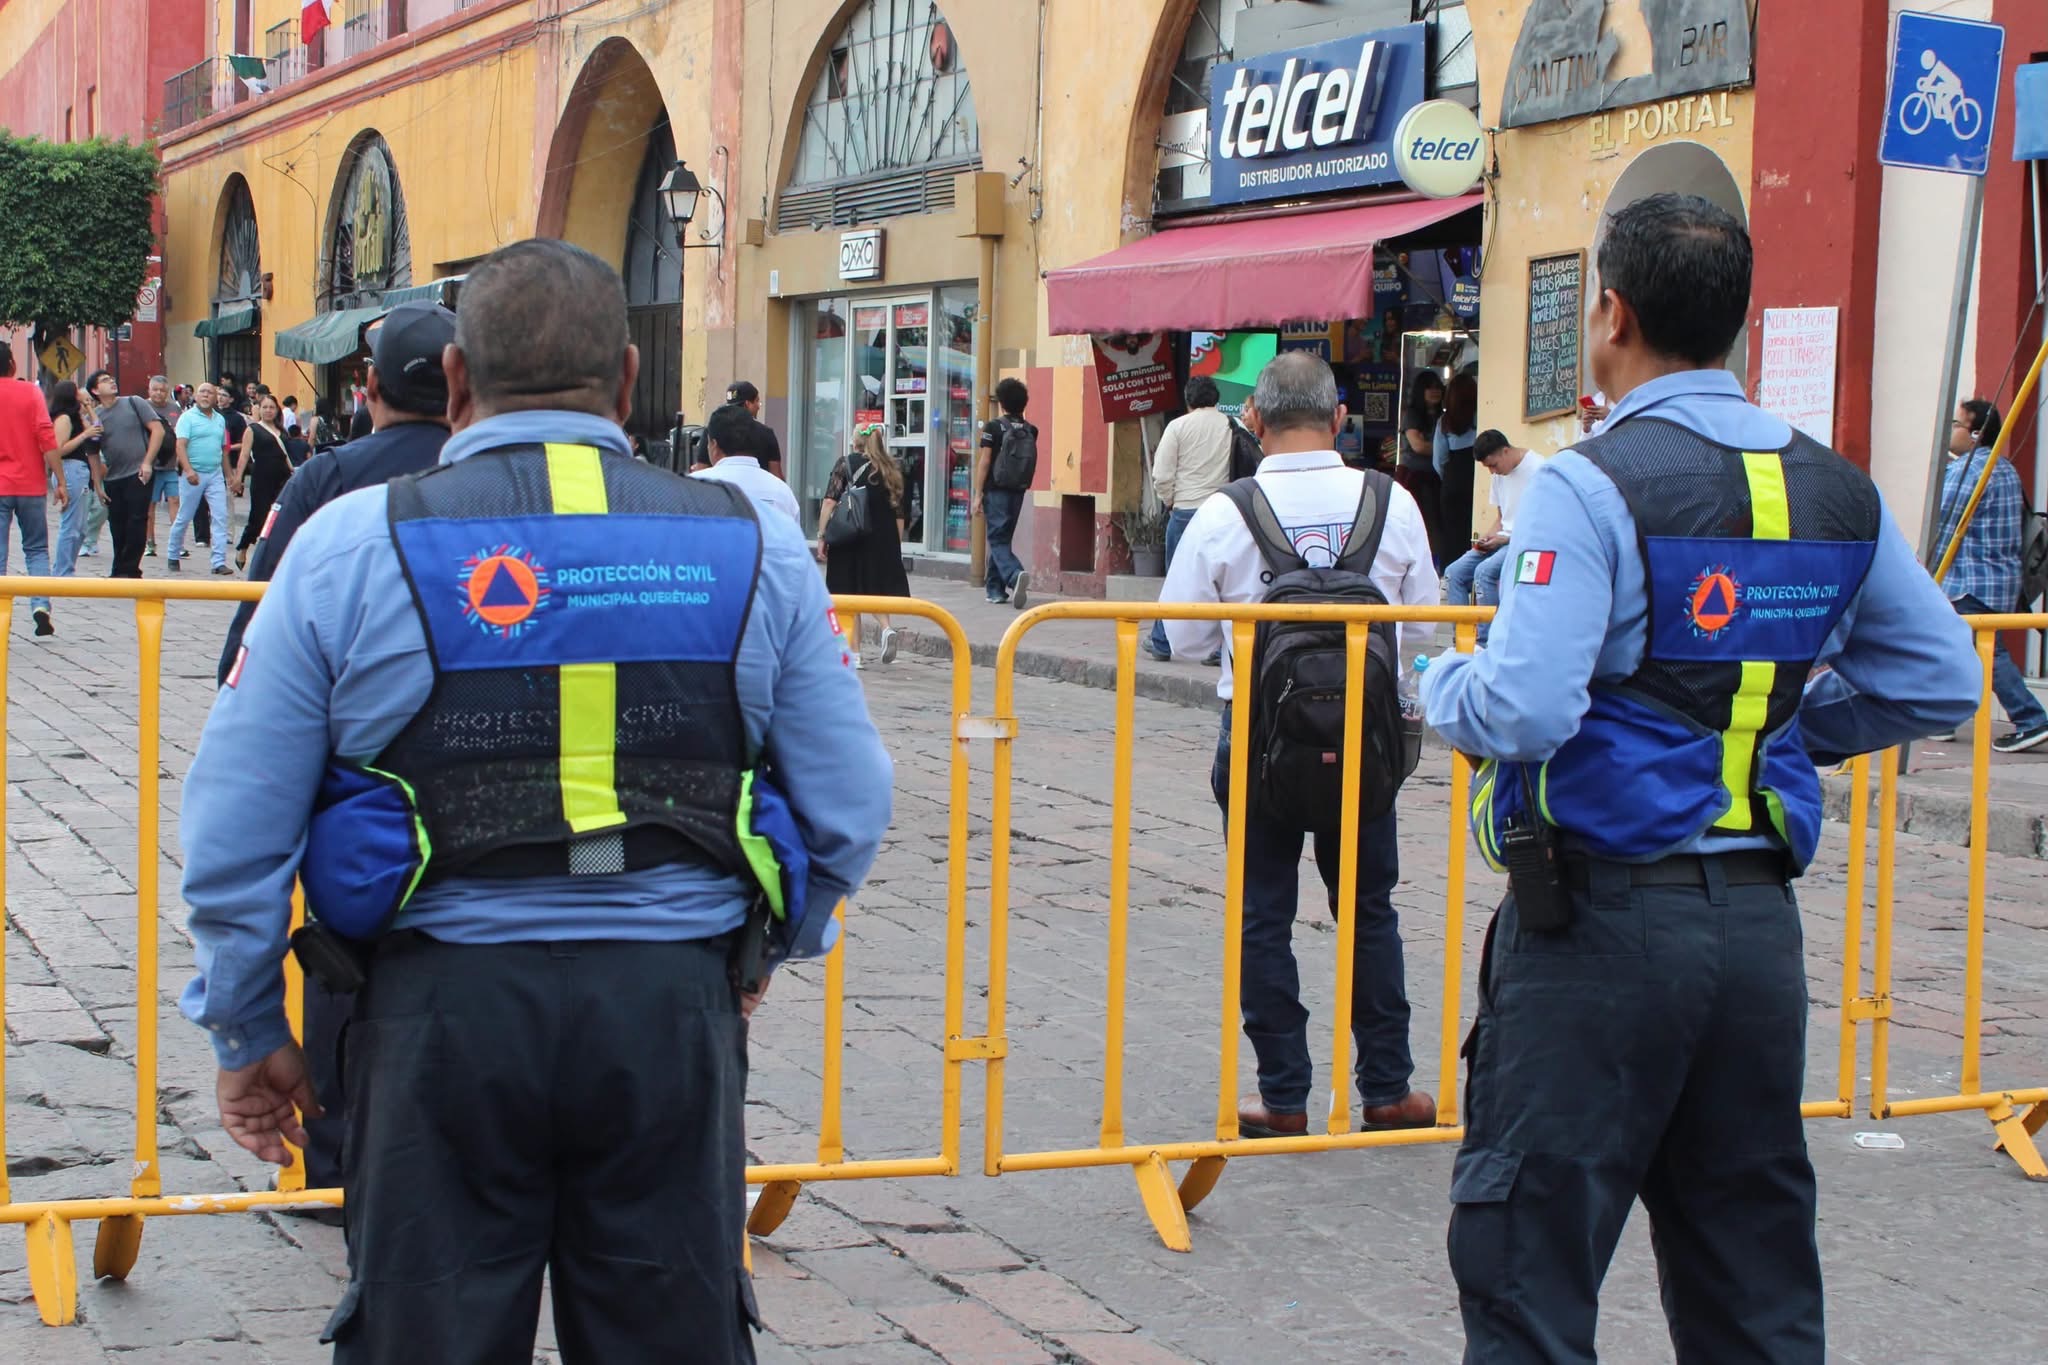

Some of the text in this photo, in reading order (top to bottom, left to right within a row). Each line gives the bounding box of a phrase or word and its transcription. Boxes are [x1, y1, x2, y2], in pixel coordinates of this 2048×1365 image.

[1680, 20, 1728, 68] BAR
[1219, 40, 1376, 159] telcel
[1590, 92, 1734, 153] EL PORTAL
[1410, 137, 1480, 161] telcel
[1239, 152, 1388, 188] DISTRIBUIDOR AUTORIZADO
[841, 239, 873, 269] OXXO
[1374, 281, 1402, 292] QUIPO
[1452, 294, 1471, 303] telcel
[1283, 321, 1328, 333] RATIS
[1106, 364, 1165, 382] en 10 minutos
[1102, 382, 1125, 393] SOLO
[1126, 379, 1144, 388] CON
[1145, 375, 1157, 385] TU
[1113, 393, 1124, 401] sin
[1125, 389, 1148, 399] revisar
[557, 559, 716, 585] PROTECCIÓN CIVIL
[567, 589, 710, 608] MUNICIPAL QUERÉTARO
[1746, 581, 1840, 600] PROTECCIÓN CIVIL
[1751, 607, 1794, 619] MUNICIPAL
[622, 703, 689, 725] CIVIL
